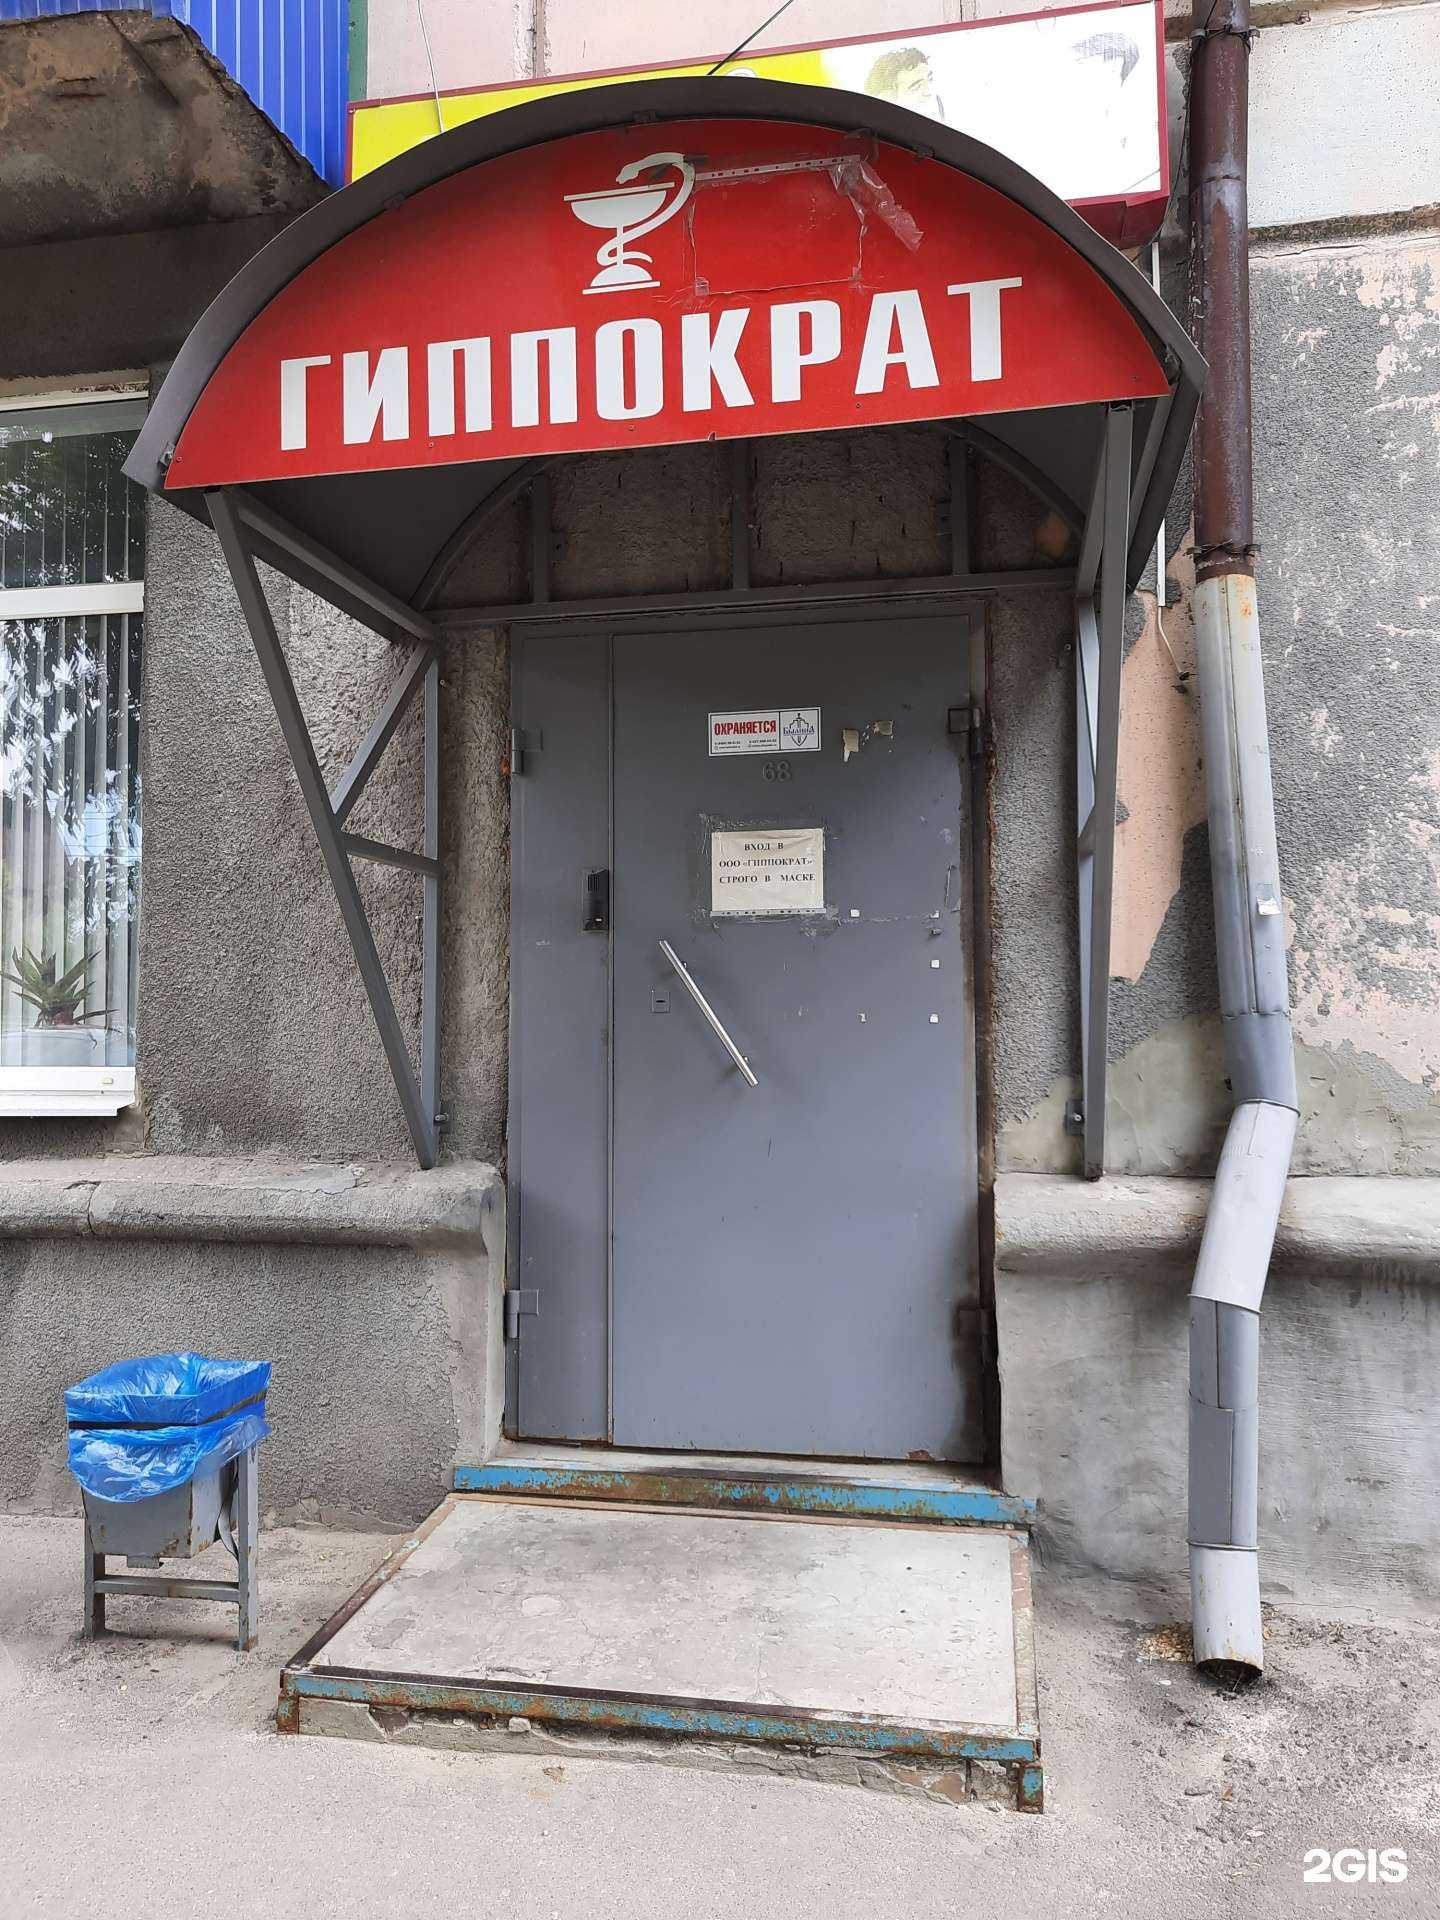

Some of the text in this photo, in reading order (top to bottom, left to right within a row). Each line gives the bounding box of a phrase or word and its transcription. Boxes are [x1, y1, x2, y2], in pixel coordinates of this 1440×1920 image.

[279, 276, 1023, 452] ГИППОКРАТ
[714, 720, 777, 736] ОХРАНЯЕТСЯ
[762, 761, 791, 782] 68
[744, 843, 770, 852] ВХОД
[719, 860, 741, 868] ООО
[719, 873, 816, 884] СТРОГО В МАСКЕ
